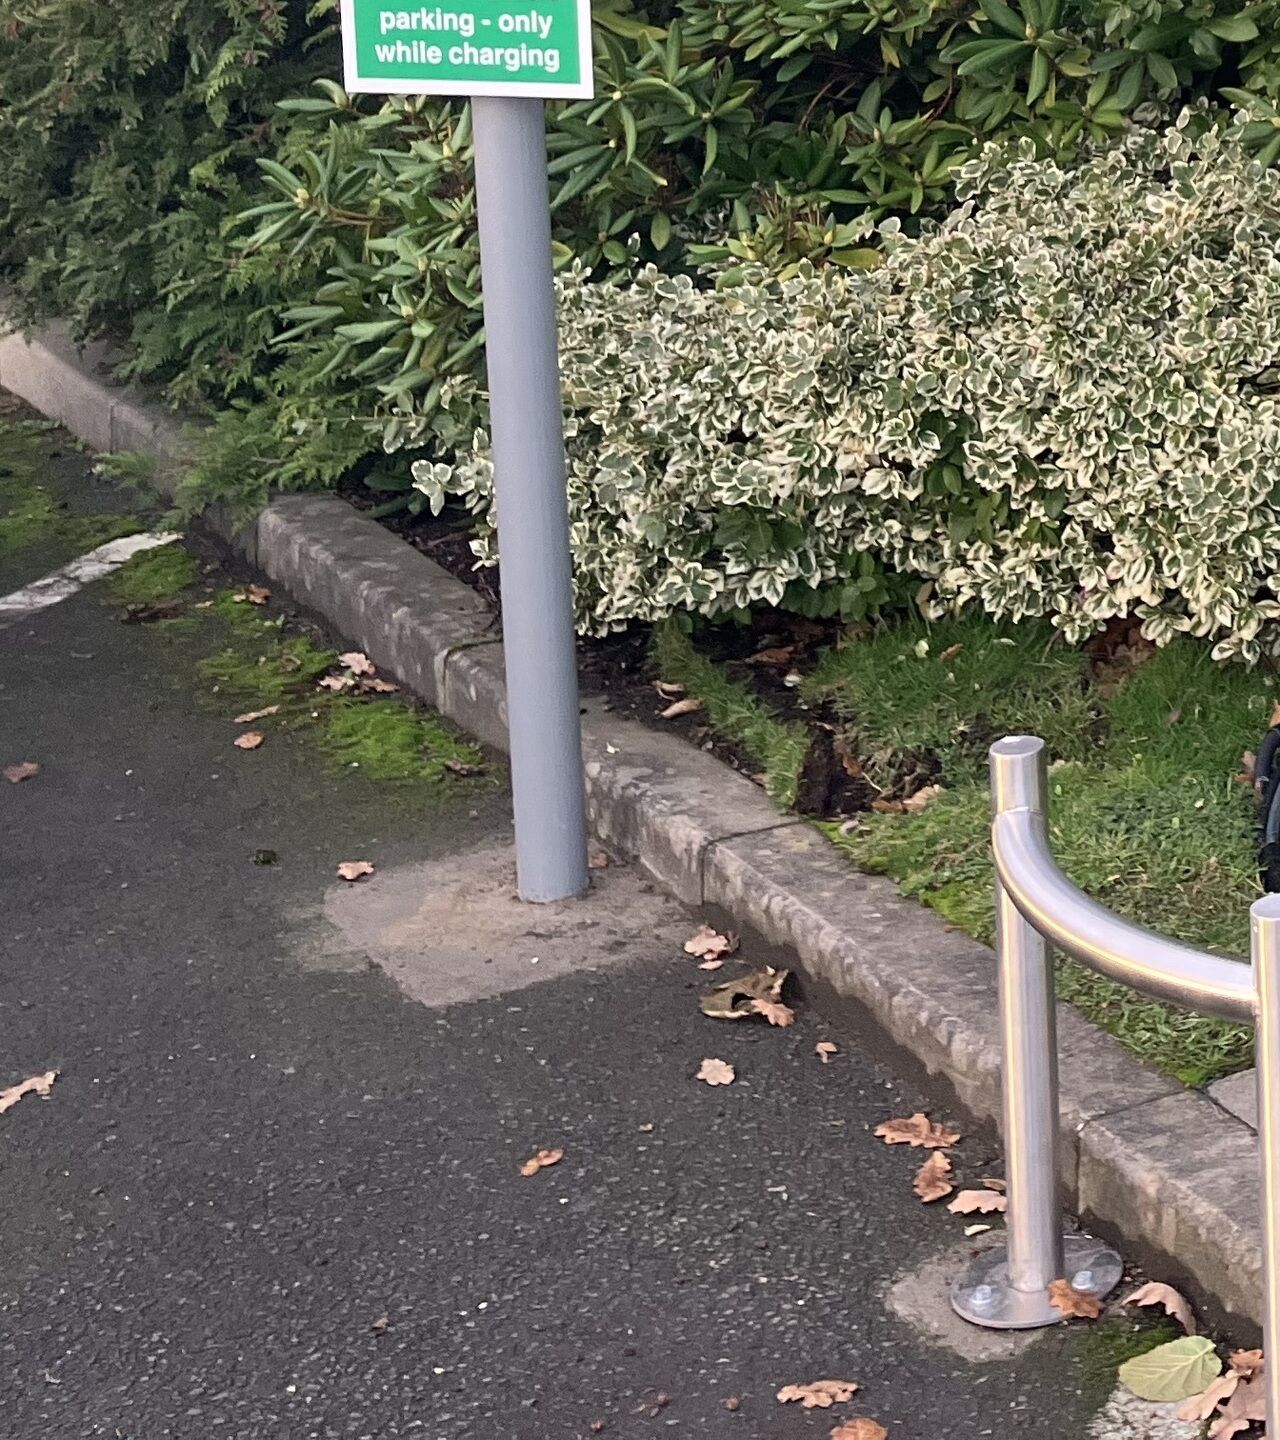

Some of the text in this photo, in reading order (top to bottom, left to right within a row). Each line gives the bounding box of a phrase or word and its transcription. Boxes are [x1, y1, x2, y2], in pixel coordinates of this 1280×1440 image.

[380, 8, 474, 37] parking
[499, 11, 553, 39] only
[375, 40, 560, 73] while charging
